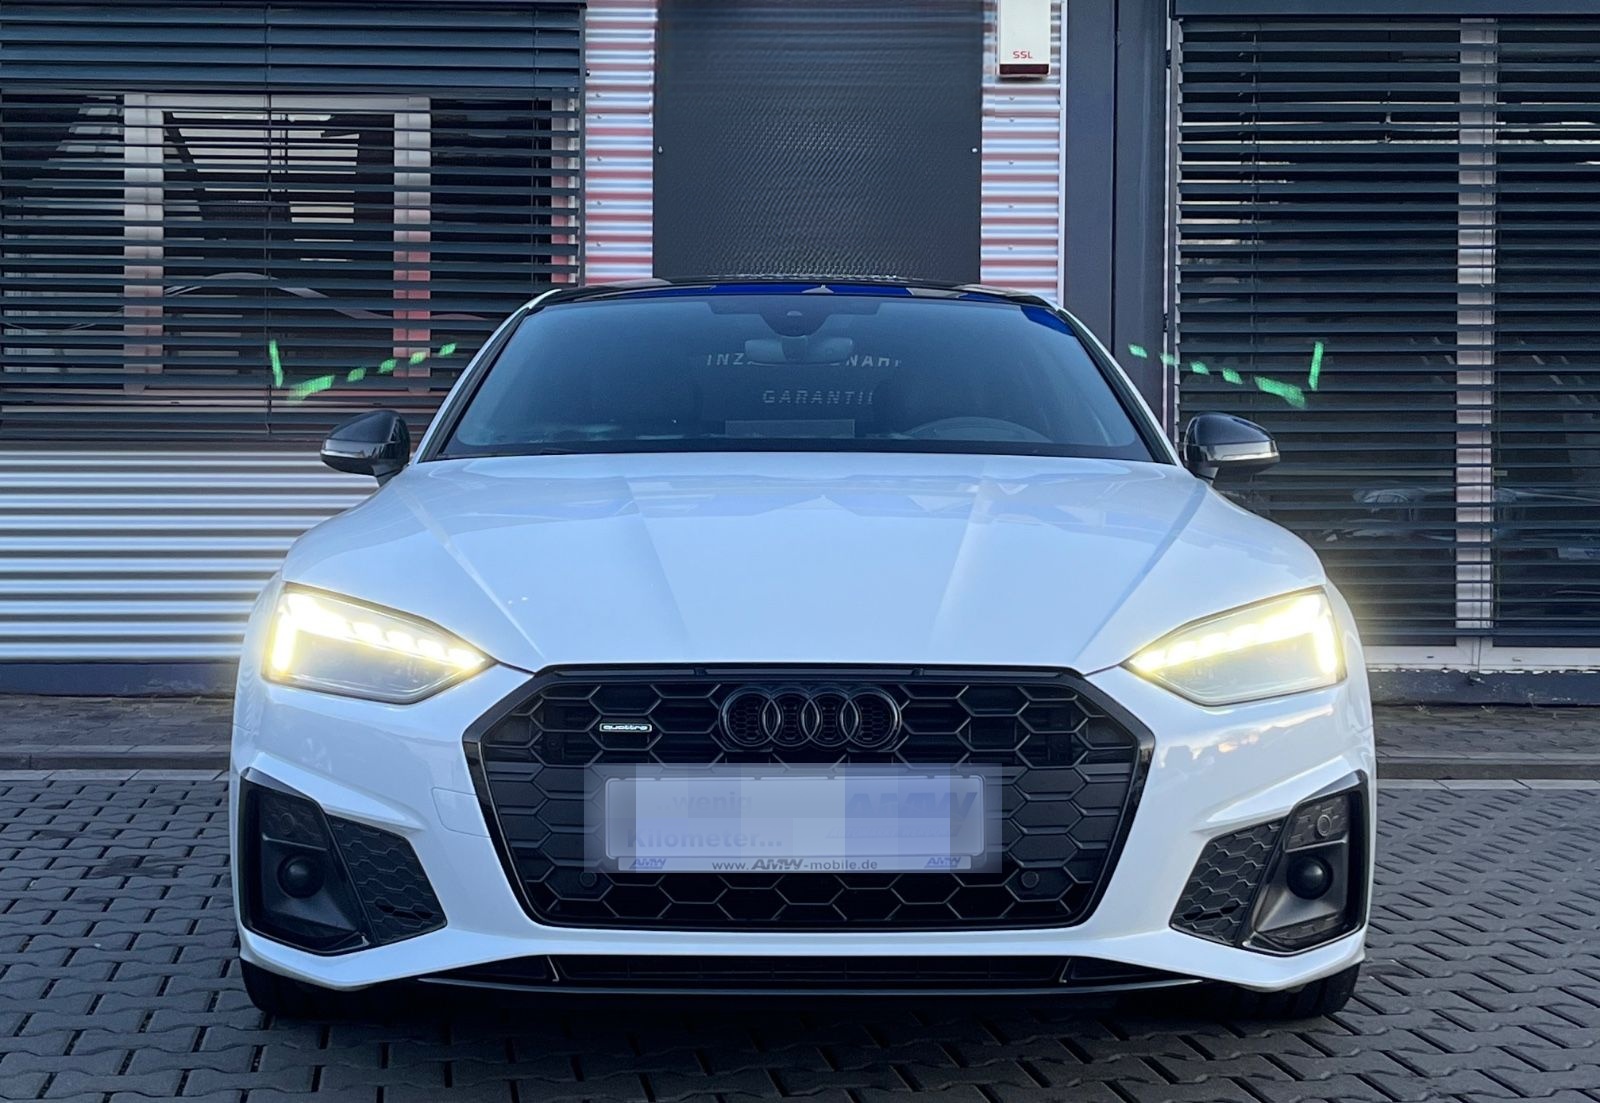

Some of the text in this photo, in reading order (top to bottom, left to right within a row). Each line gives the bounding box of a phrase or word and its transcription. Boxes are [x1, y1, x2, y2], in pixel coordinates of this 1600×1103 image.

[1012, 50, 1033, 59] SSL
[602, 724, 649, 732] quattro
[627, 827, 783, 848] Kilometer...
[631, 857, 667, 868] AMW
[711, 857, 878, 871] www.AMW-mobile.de
